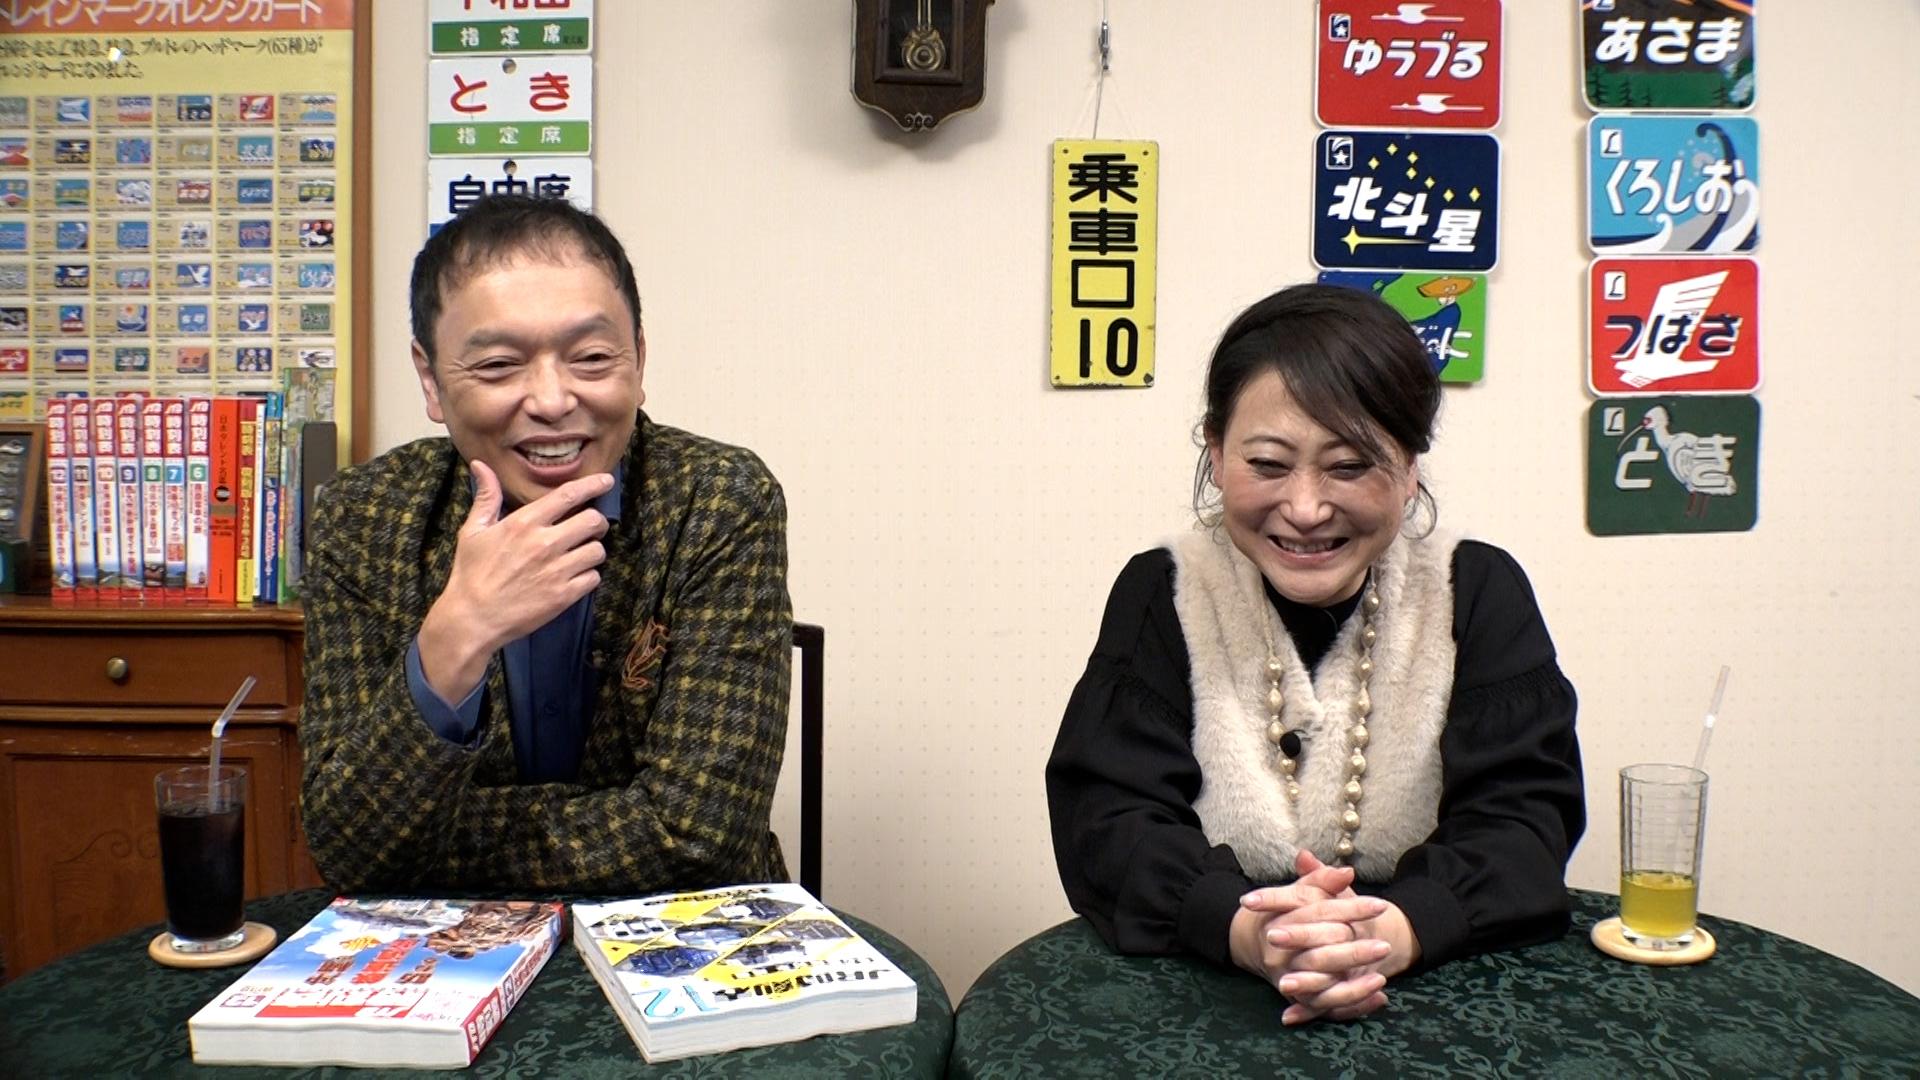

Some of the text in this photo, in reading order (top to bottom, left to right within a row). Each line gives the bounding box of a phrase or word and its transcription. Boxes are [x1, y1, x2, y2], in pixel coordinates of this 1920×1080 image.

[460, 24, 561, 46] 指定席
[1343, 32, 1489, 79] ゆうづる
[1595, 17, 1743, 64] あさま
[450, 72, 570, 112] とき
[457, 126, 561, 145] 指定席
[1605, 159, 1745, 215] くろしお
[1068, 154, 1139, 308] 乗車口
[1327, 177, 1482, 252] 北斗星
[1080, 317, 1139, 378] 10
[1604, 311, 1743, 359] つばさ
[1615, 434, 1737, 489] とき
